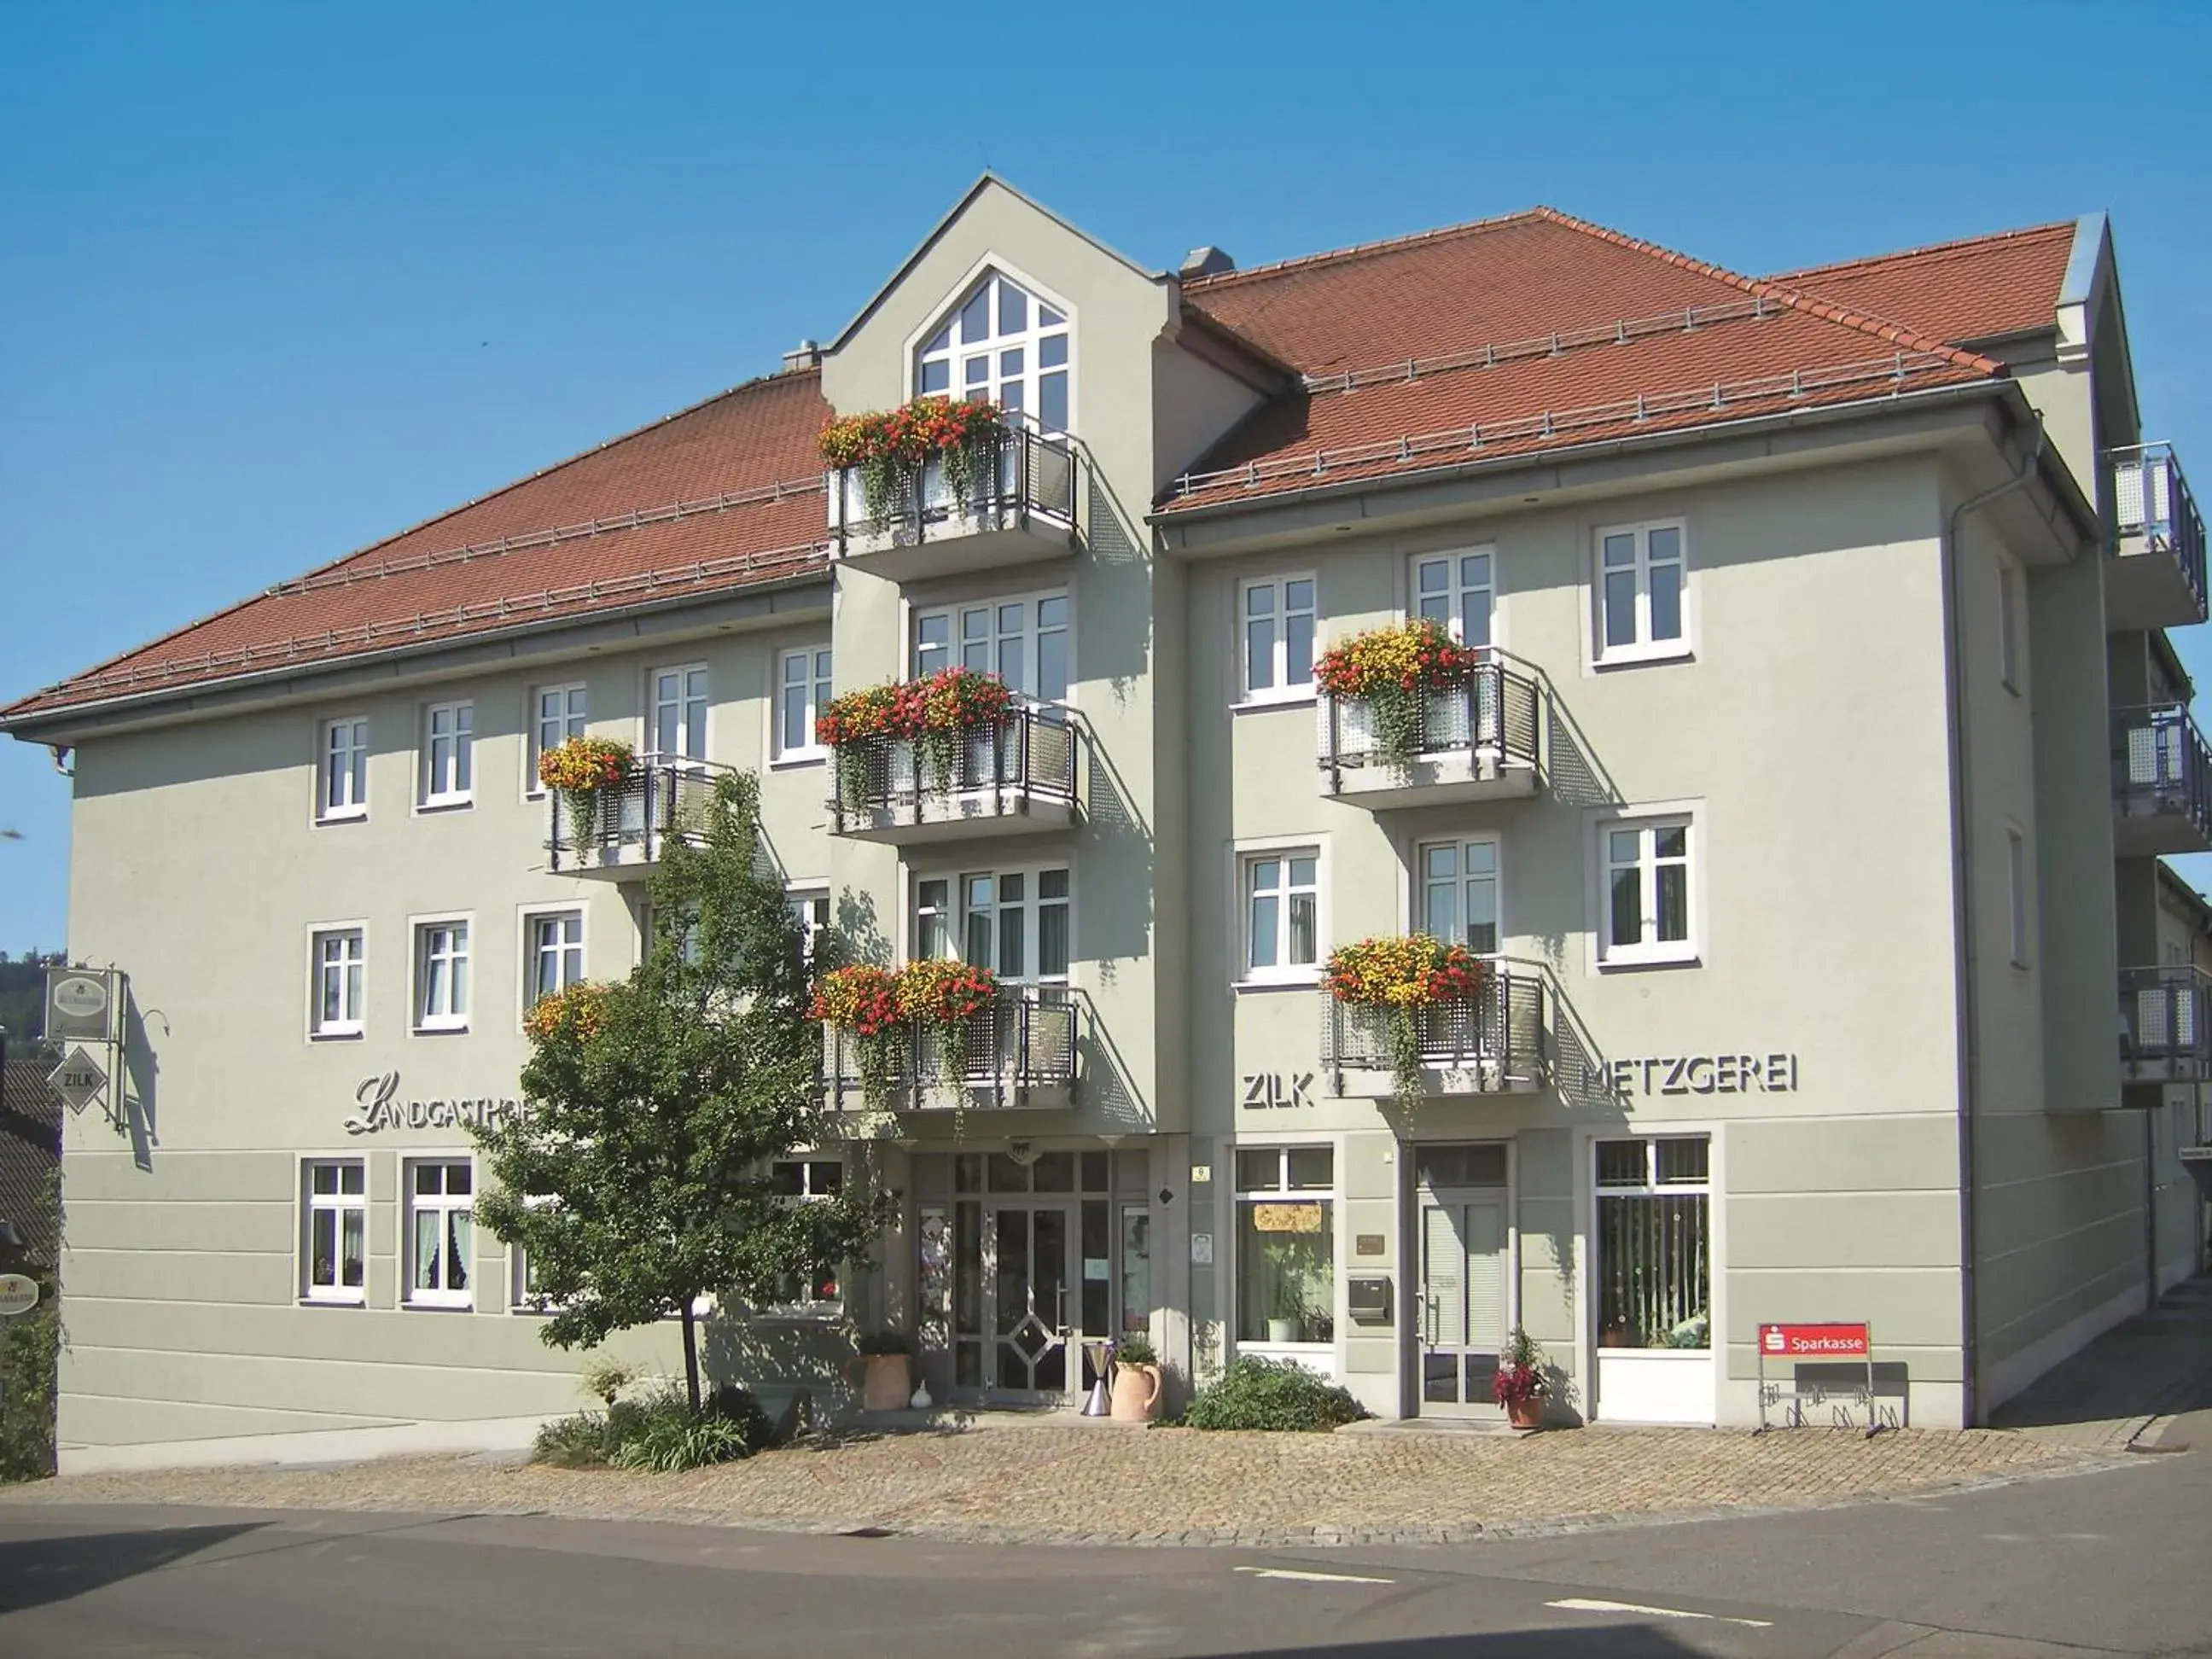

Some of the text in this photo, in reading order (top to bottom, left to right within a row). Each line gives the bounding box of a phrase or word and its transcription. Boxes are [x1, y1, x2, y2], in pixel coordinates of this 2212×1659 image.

[64, 1073, 93, 1086] ZILK
[1243, 1072, 1314, 1109] ZILK
[1791, 1335, 1864, 1352] Sparkasse
